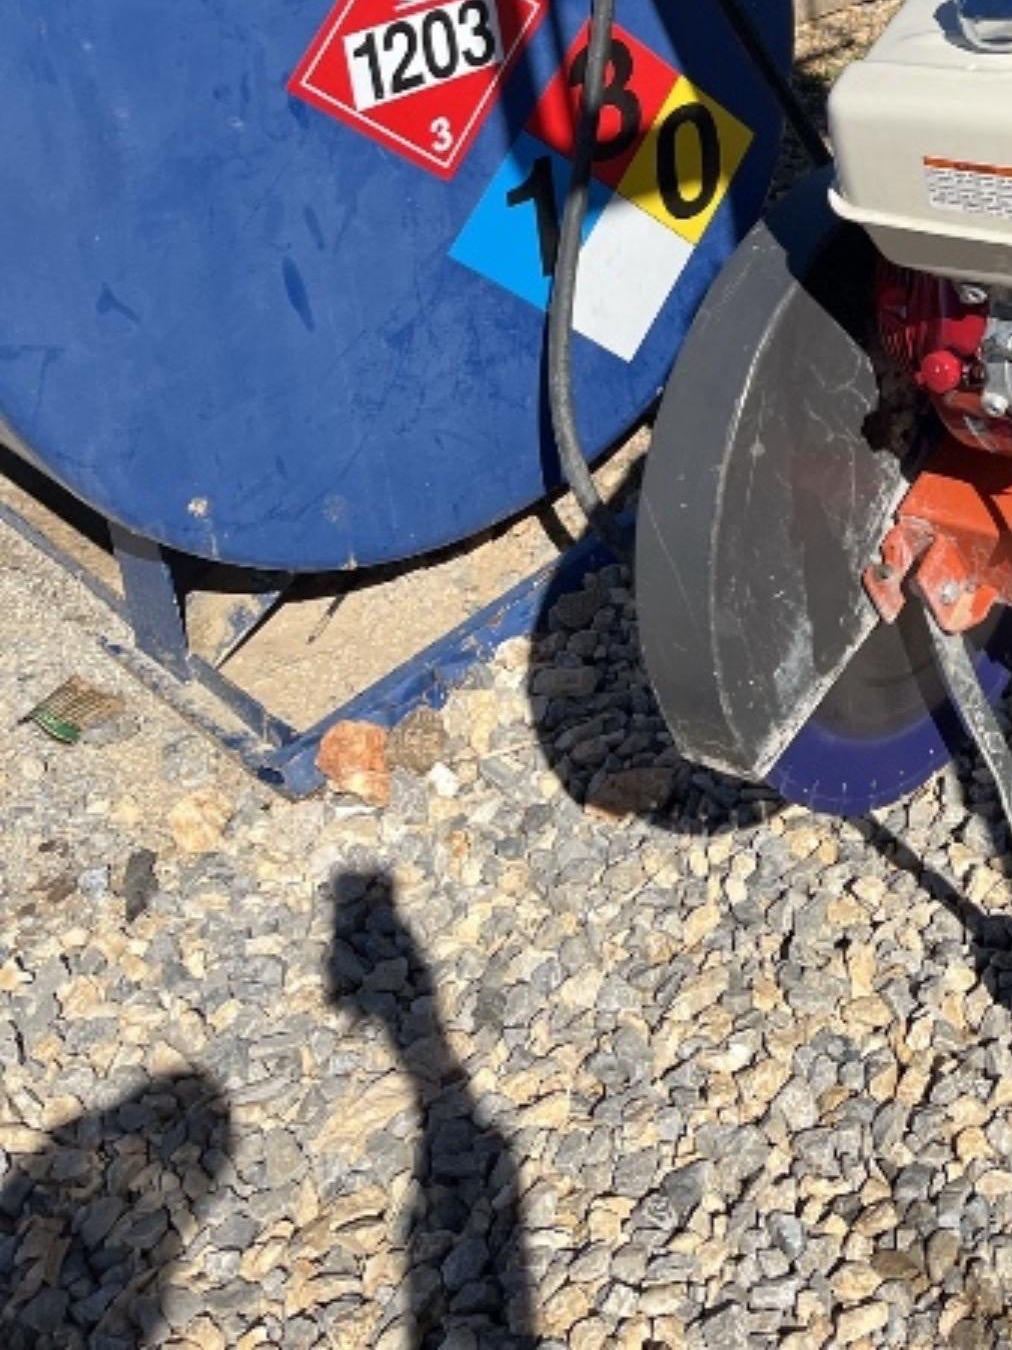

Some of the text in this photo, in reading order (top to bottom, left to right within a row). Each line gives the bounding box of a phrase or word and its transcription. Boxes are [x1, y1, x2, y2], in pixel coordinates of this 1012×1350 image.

[430, 116, 453, 152] 3
[656, 102, 721, 220] 0
[506, 155, 560, 277] 1
